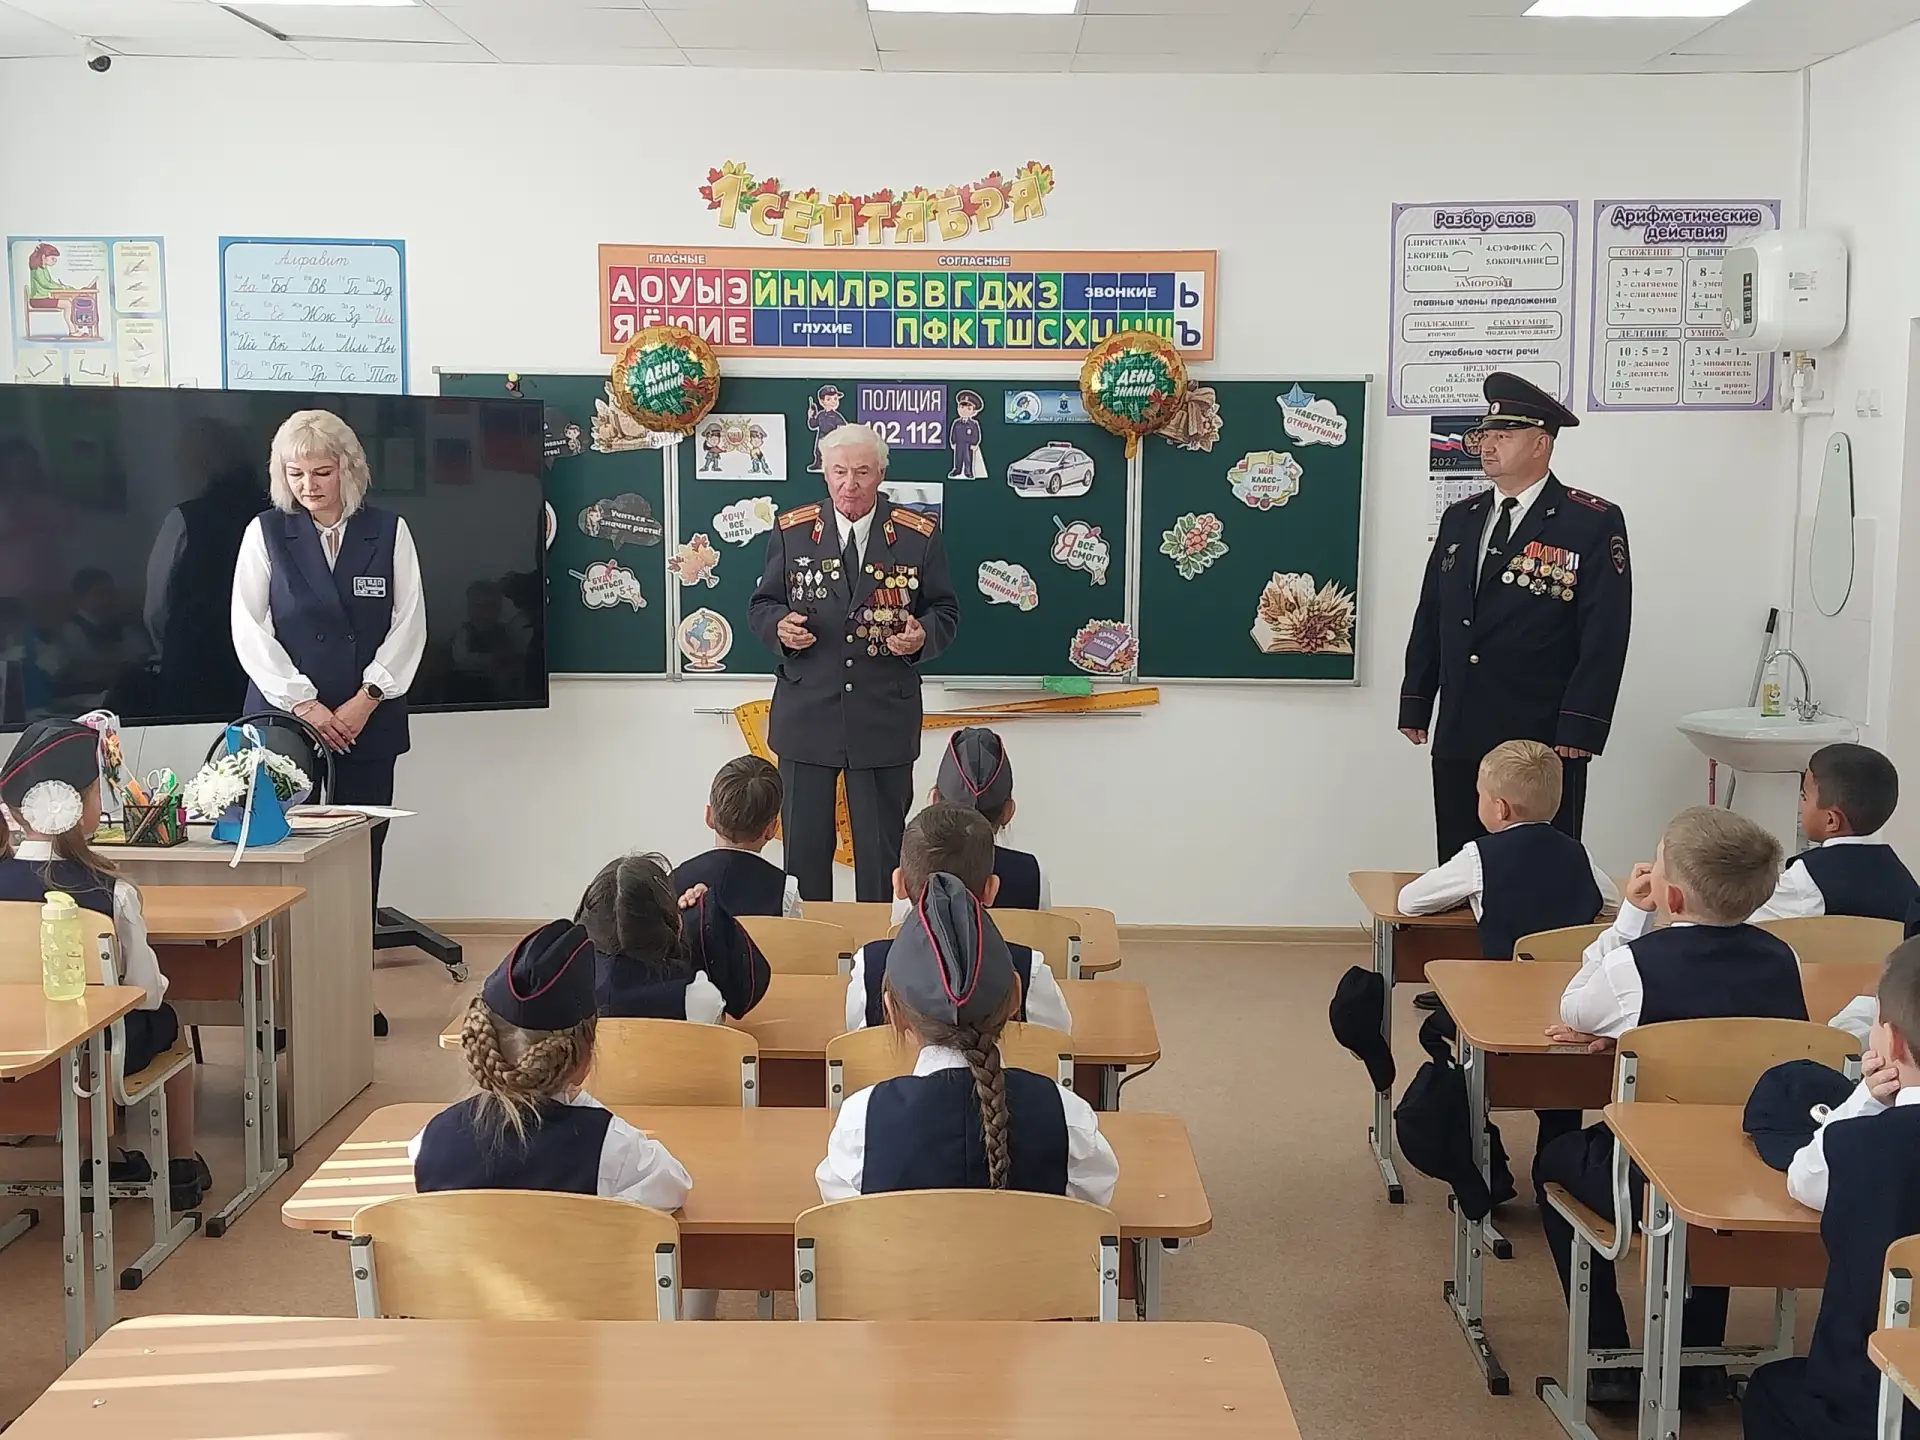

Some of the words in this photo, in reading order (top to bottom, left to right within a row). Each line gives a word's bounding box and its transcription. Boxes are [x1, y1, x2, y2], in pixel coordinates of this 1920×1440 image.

[712, 174, 742, 228] 1
[749, 175, 1045, 246] СЕНТЯБРЯ
[1613, 207, 1760, 227] Арифметические
[1435, 210, 1493, 229] Разбор
[1496, 211, 1534, 226] слов
[1646, 226, 1725, 241] действия
[275, 249, 349, 270] Алфавит
[649, 253, 705, 265] ГЛАСНЫЕ
[938, 255, 1011, 267] СОГЛАСНЫЕ
[271, 276, 294, 293] Бб
[308, 278, 327, 294] Вв
[373, 279, 393, 301] Дд
[1084, 287, 1157, 298] ЗВОНКИЕ
[1179, 281, 1200, 308] Ь
[1413, 299, 1454, 307] главные
[1457, 298, 1488, 306] члены
[1491, 297, 1557, 306] предложения
[300, 305, 337, 322] Жж
[793, 322, 853, 335] ГЛУХИЕ
[1176, 320, 1201, 346] Ъ
[1618, 329, 1668, 338] ДЕЛЕНИЕ
[268, 334, 288, 350] Кк
[301, 336, 325, 351] Лл
[337, 336, 368, 353] Мм
[375, 337, 397, 353] Нн
[1429, 348, 1483, 358] служебные
[1486, 348, 1513, 356] части
[1516, 347, 1539, 357] речи
[268, 363, 294, 380] Пп
[340, 365, 356, 381] Сс
[366, 365, 398, 383] Тт
[645, 360, 679, 385] ДЕНЬ
[1117, 369, 1155, 386] ДЕНЬ
[645, 372, 684, 398] ЗНАНИЙ
[1113, 384, 1156, 397] ЗНАНИЙ
[1430, 385, 1454, 393] СОЮЗ
[862, 389, 941, 414] ПОЛИЦИЯ
[1295, 408, 1342, 429] НАВСТРЕЧУ
[1287, 417, 1342, 441] ОТКРЫТИЯМ!
[1432, 458, 1457, 466] 2027
[600, 519, 632, 530] значит
[611, 509, 646, 523] Учиться
[722, 510, 745, 522] ХОЧУ
[724, 528, 752, 539] ЗНАТЬ!
[1056, 532, 1078, 557] Я
[1071, 550, 1106, 564] СМОГУ!
[981, 563, 1011, 583] ВПЕРЁД
[589, 579, 623, 593] УЧИТЬСЯ
[980, 577, 1020, 600] ЗНАНИЯМ!
[604, 591, 615, 599] НА
